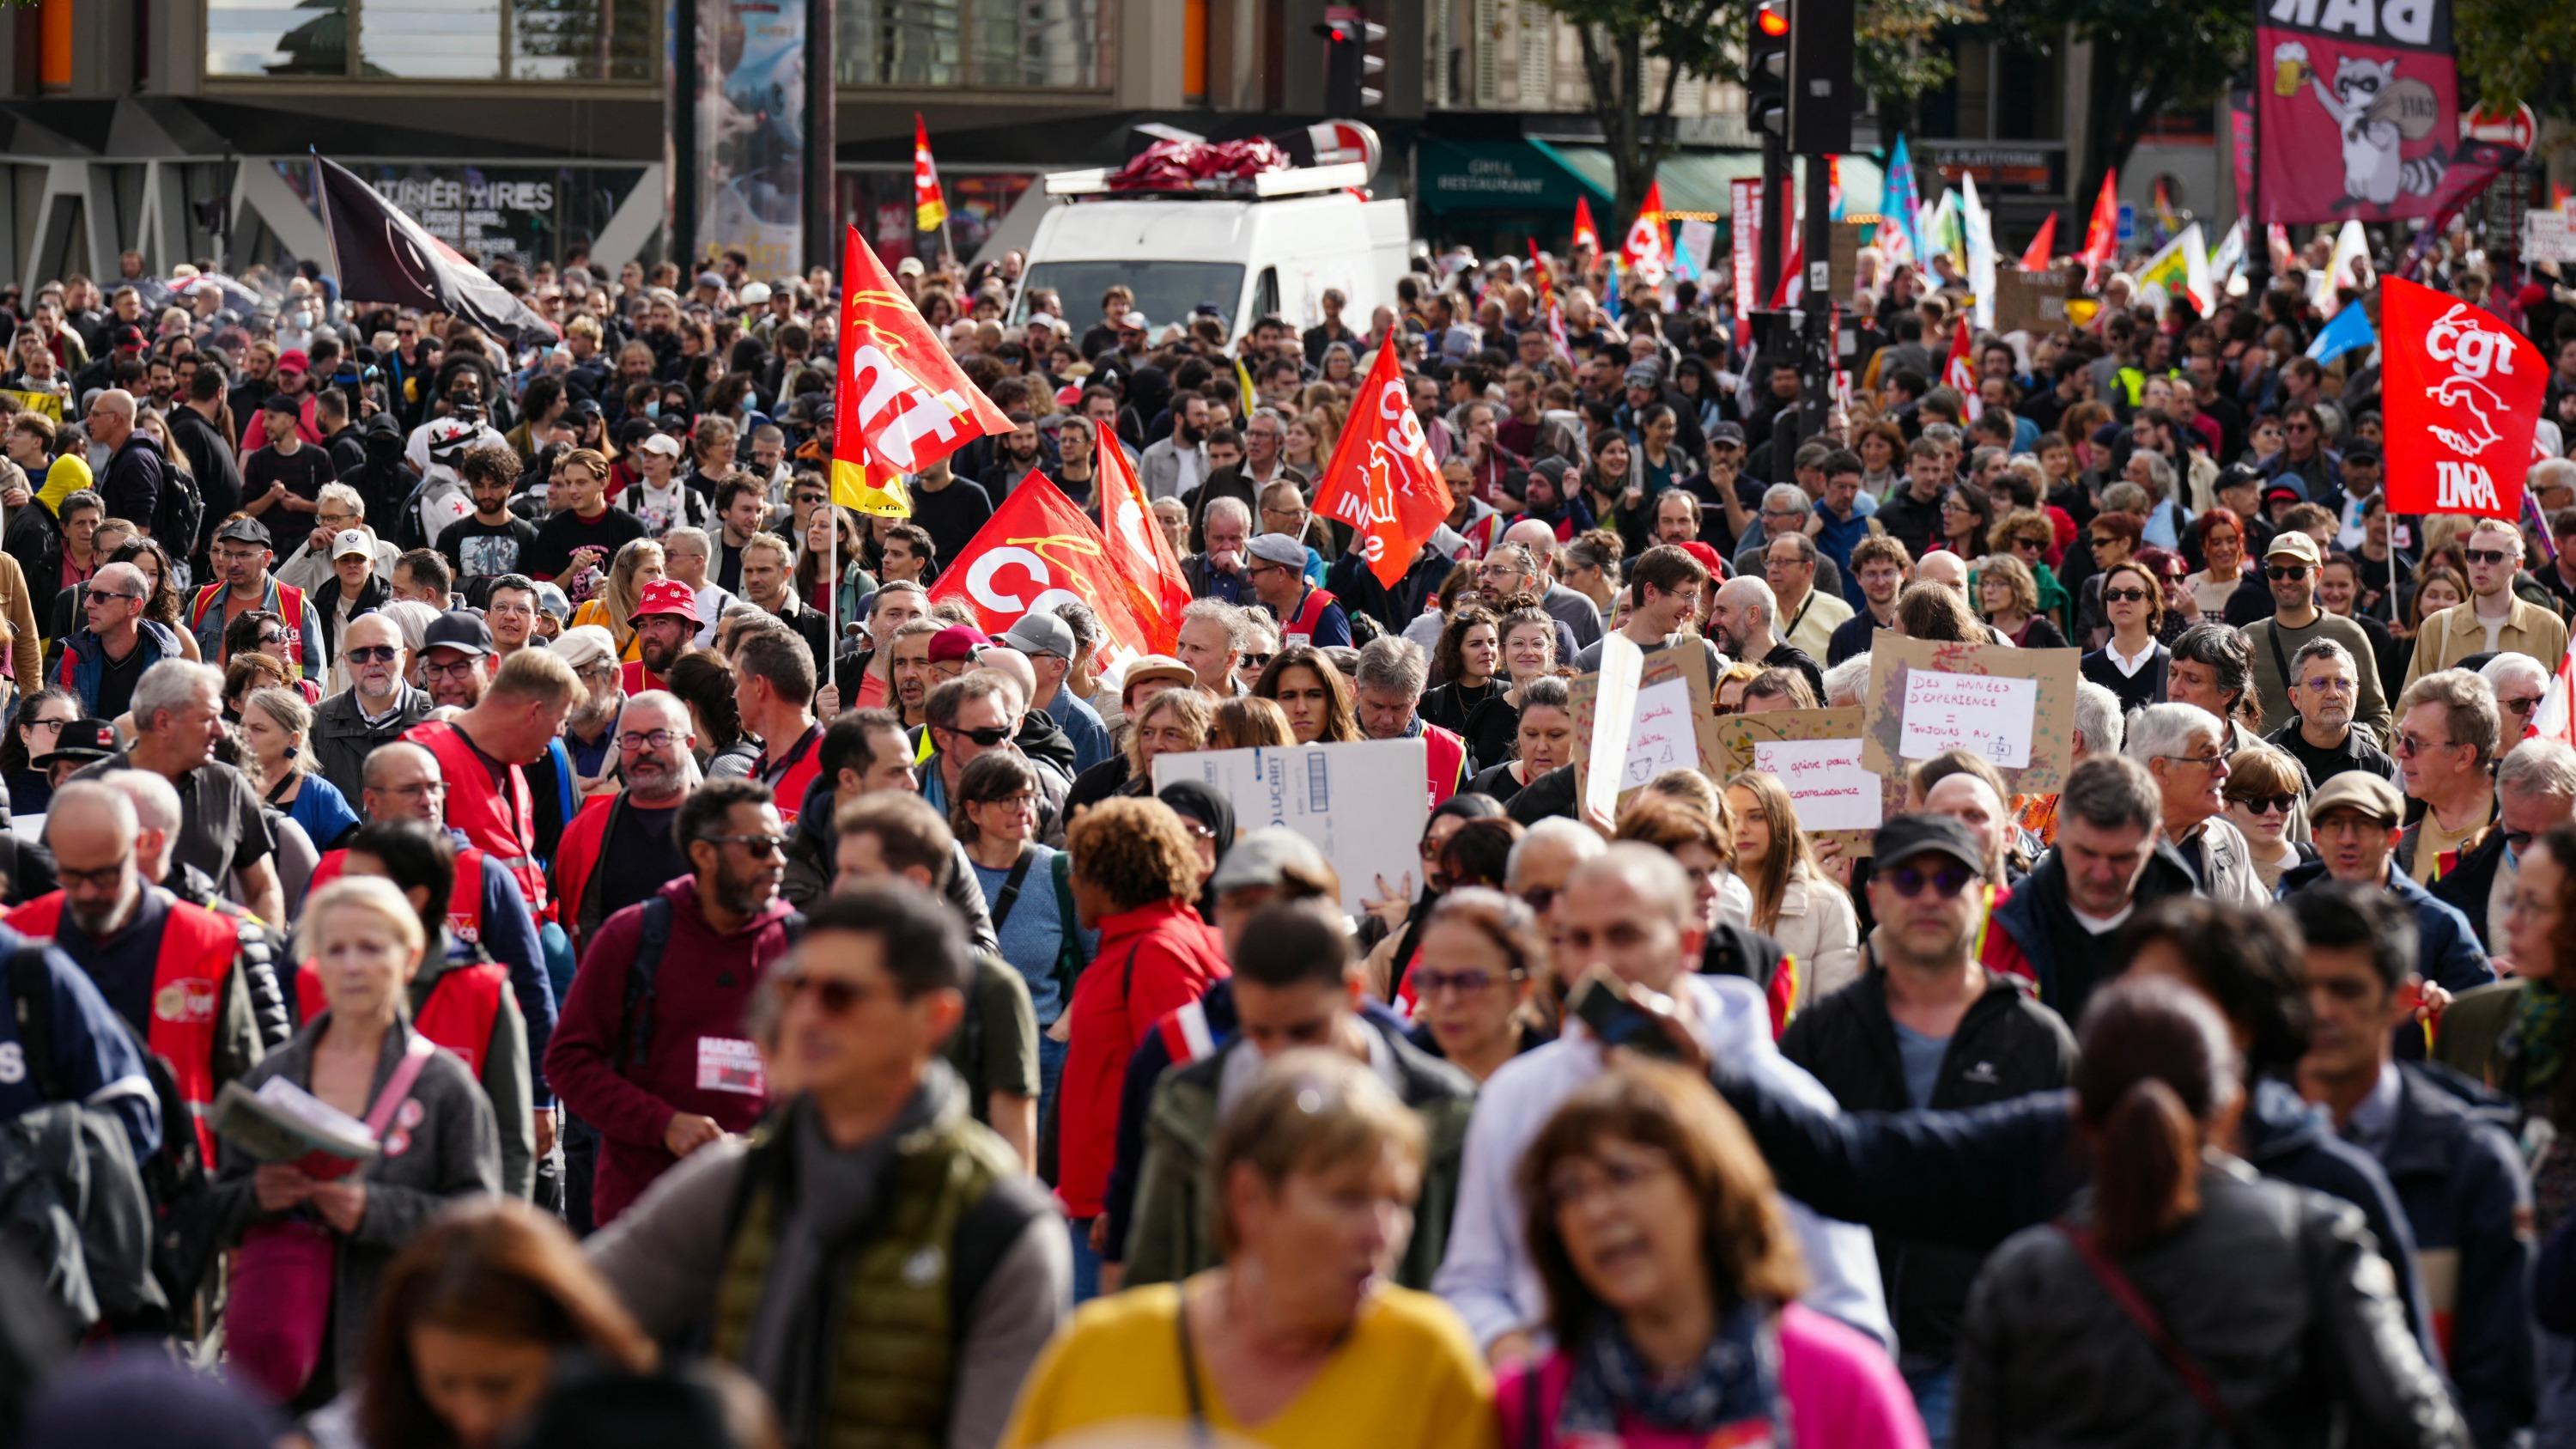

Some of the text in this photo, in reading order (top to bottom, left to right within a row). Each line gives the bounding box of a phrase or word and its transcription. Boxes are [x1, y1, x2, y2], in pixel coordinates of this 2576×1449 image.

[1437, 175, 1543, 193] RESTAURANT
[2426, 325, 2518, 378] cgt
[2435, 461, 2501, 511] INRA
[1268, 756, 1284, 816] LUCART
[1826, 757, 1851, 770] pour
